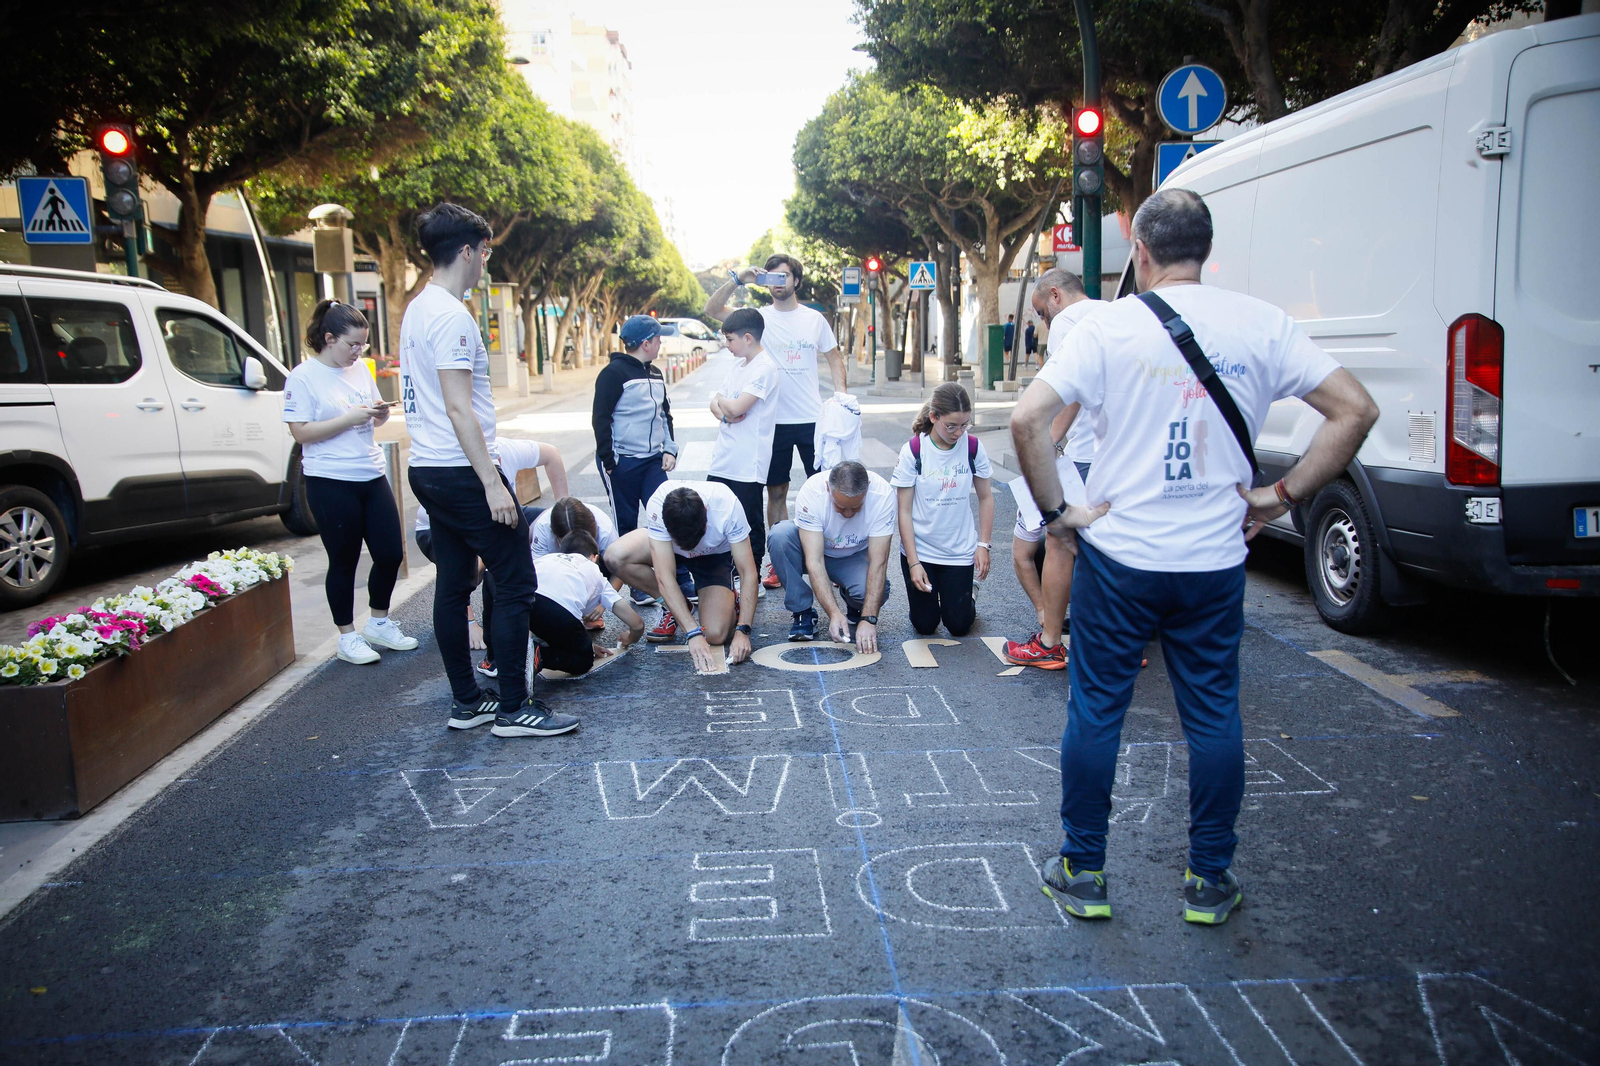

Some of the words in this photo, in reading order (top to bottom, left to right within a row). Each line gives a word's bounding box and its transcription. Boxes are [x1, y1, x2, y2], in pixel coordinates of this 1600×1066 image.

[1206, 351, 1247, 379] átima
[1163, 441, 1191, 461] JO
[1164, 462, 1192, 481] LA
[1163, 485, 1173, 493] La
[1174, 482, 1195, 492] perla
[1196, 481, 1209, 490] del
[705, 685, 960, 733] DE
[687, 841, 1070, 943] DE
